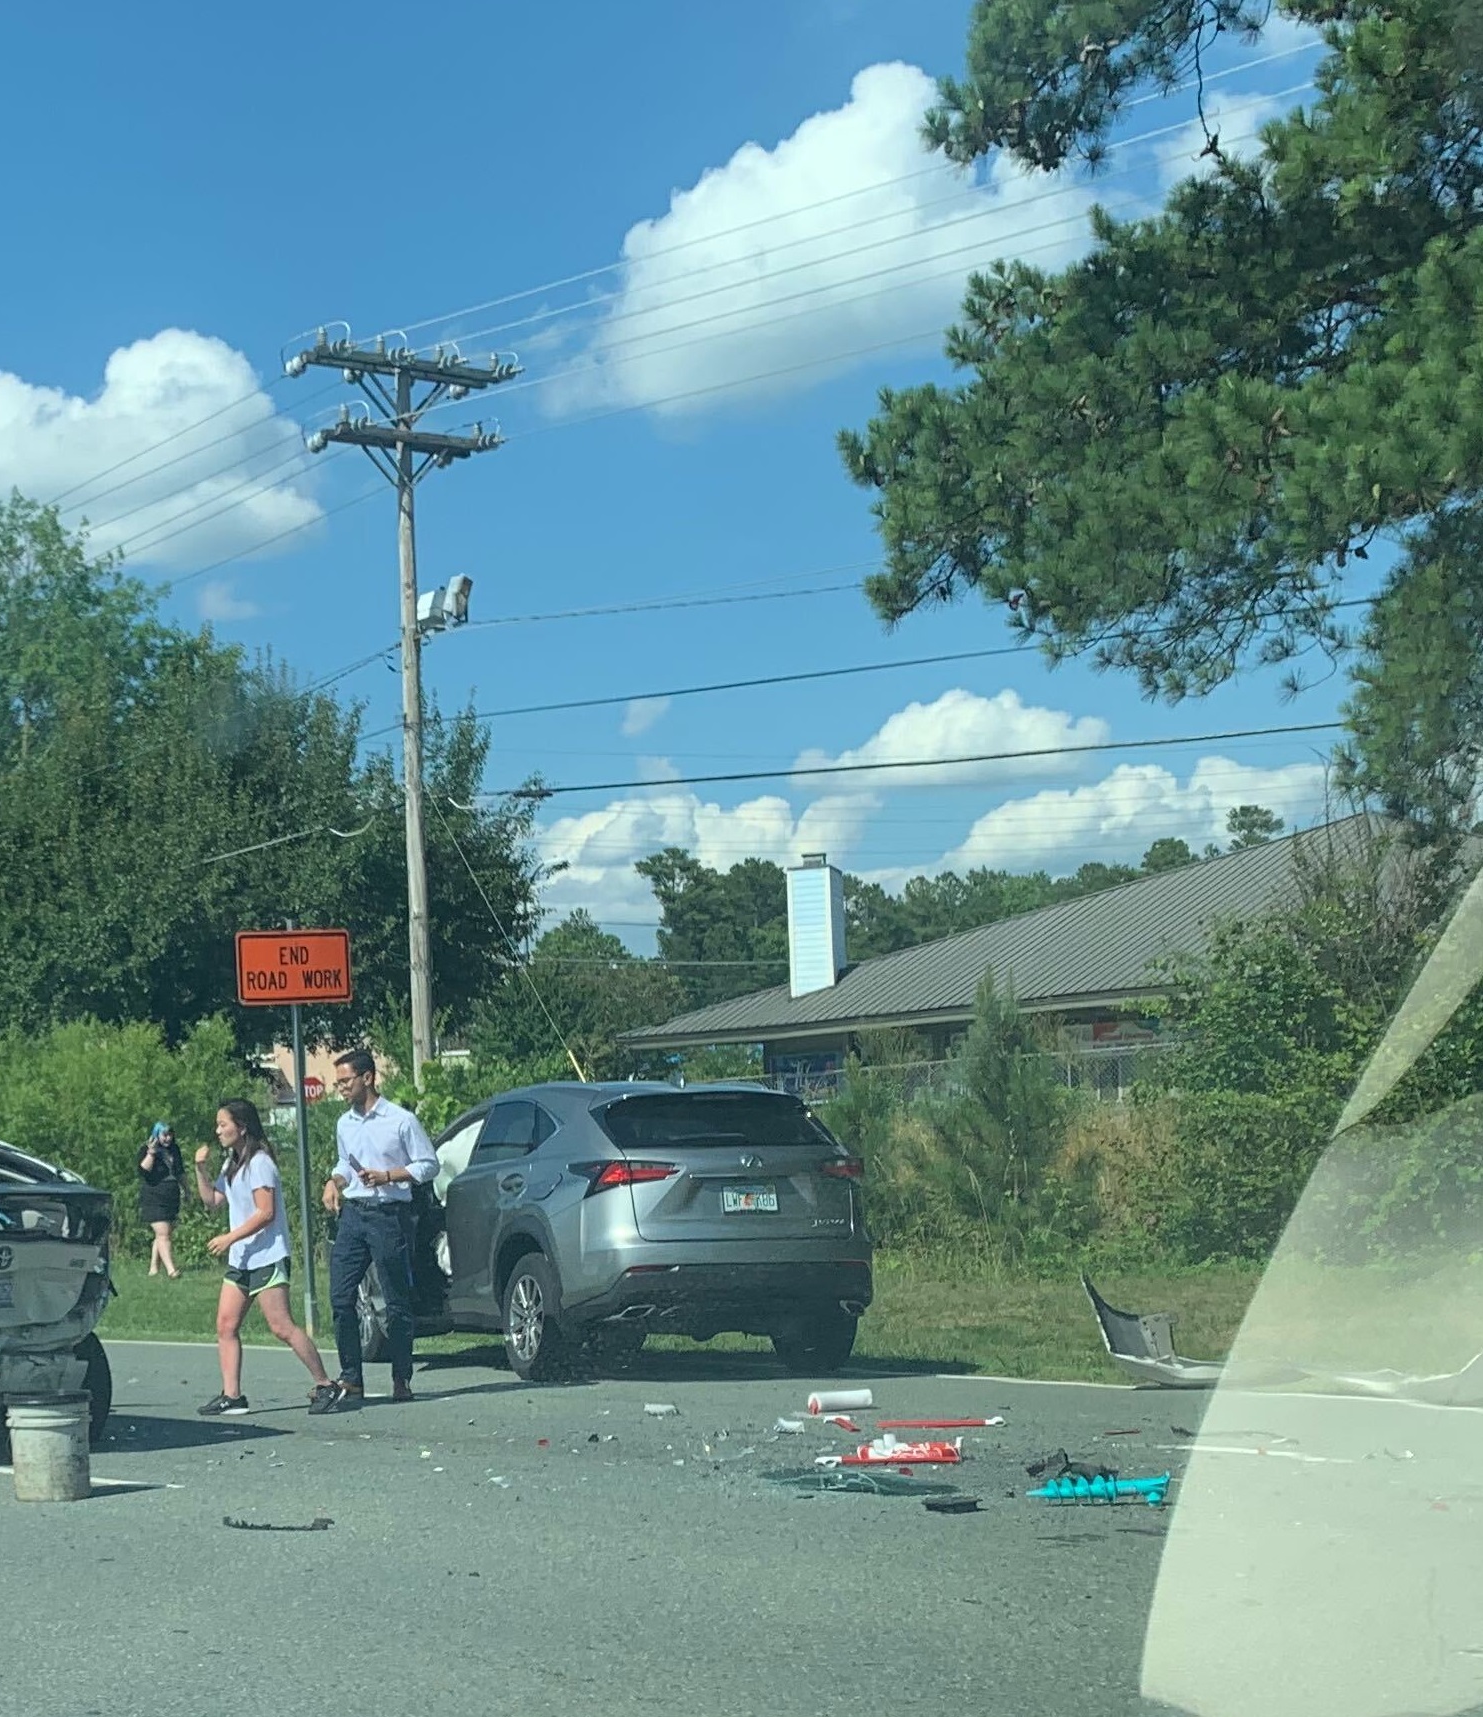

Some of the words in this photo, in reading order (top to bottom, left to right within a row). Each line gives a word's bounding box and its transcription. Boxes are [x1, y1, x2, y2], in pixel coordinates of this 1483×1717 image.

[279, 946, 309, 966] END
[246, 970, 288, 991] ROAD
[302, 968, 342, 989] WORK
[303, 1084, 324, 1098] TOP
